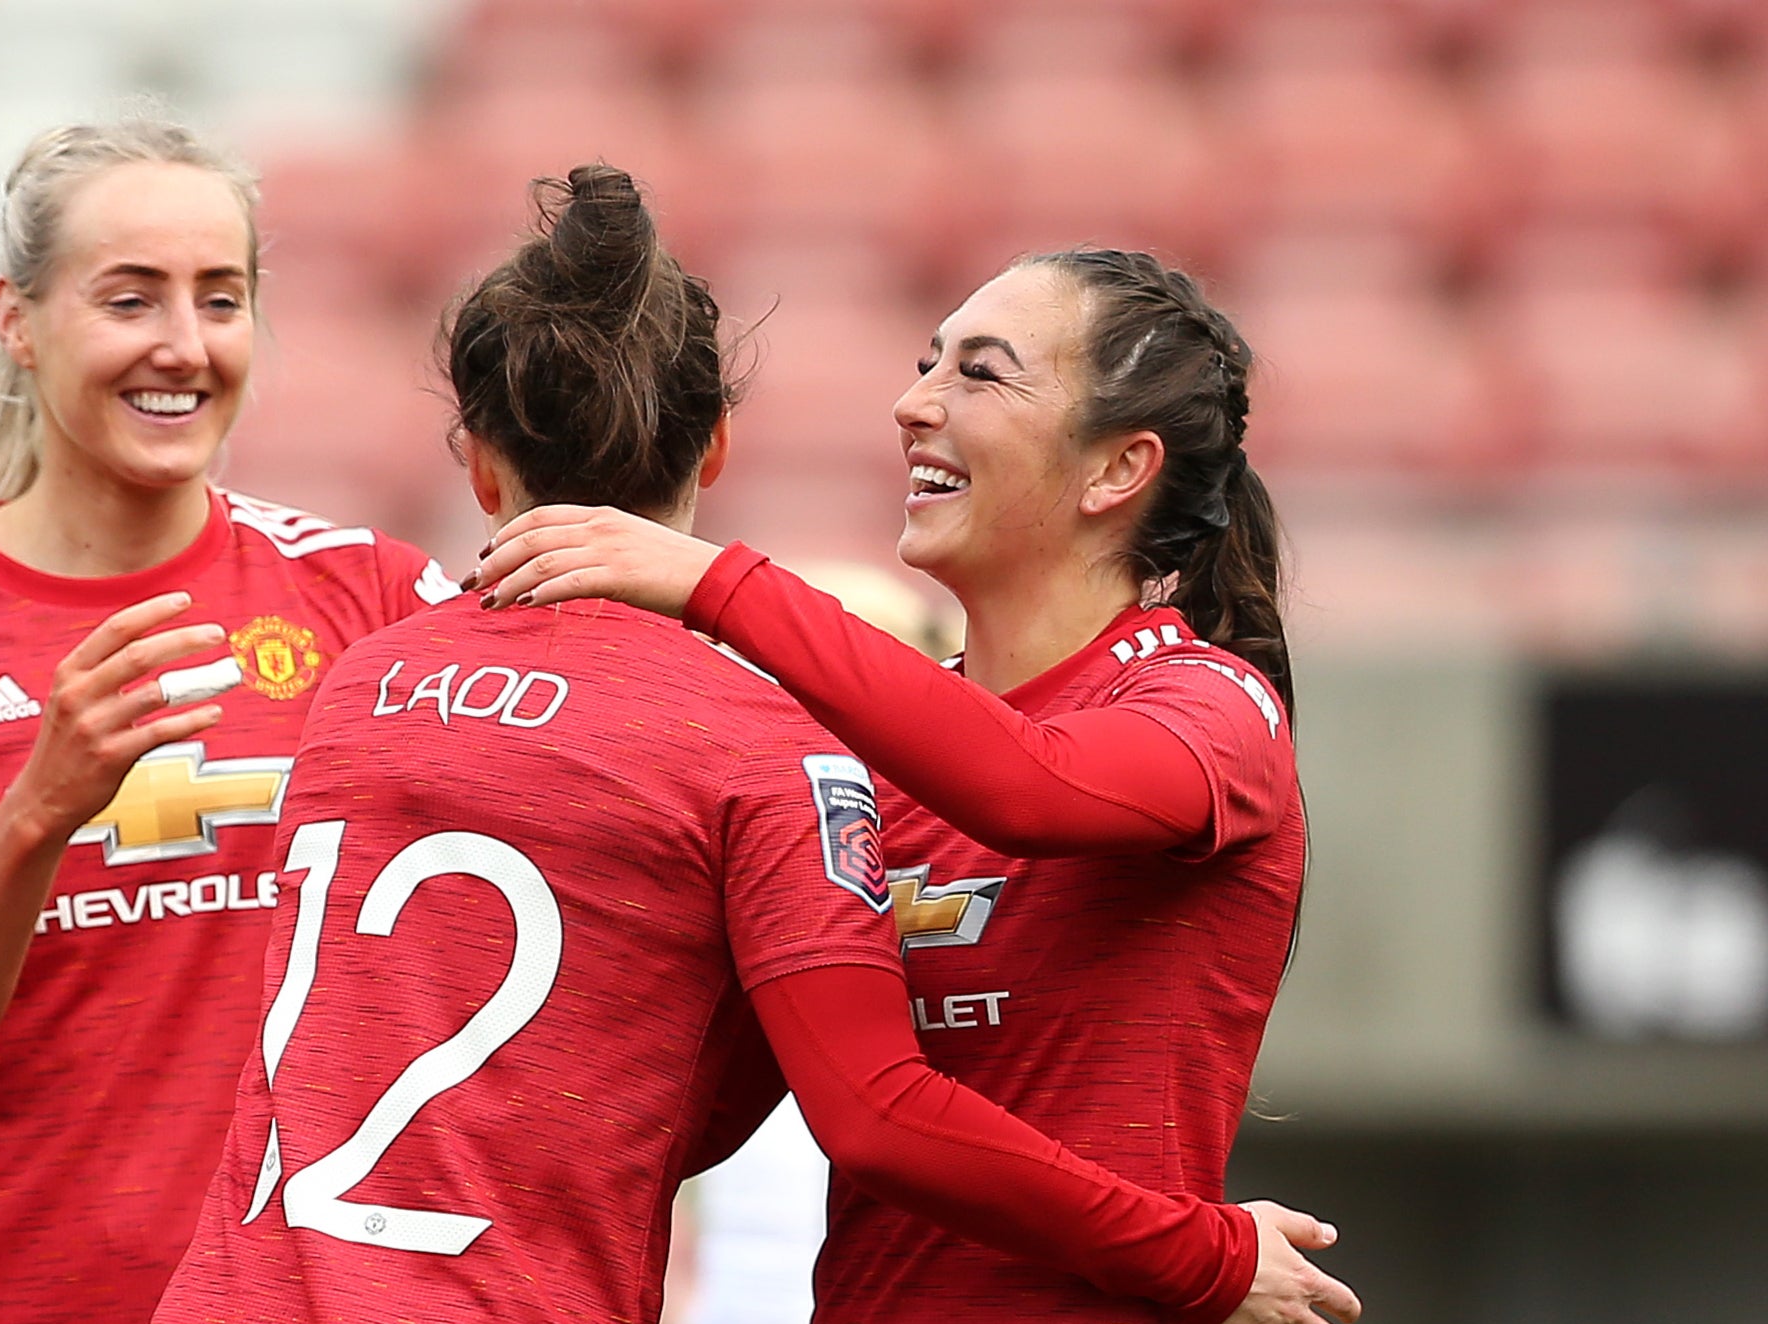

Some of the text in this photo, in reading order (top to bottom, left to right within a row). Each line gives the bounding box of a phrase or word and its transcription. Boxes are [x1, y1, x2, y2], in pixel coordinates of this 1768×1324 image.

[371, 659, 571, 728] LADD
[34, 871, 280, 934] HEVROLE
[240, 819, 564, 1256] 12
